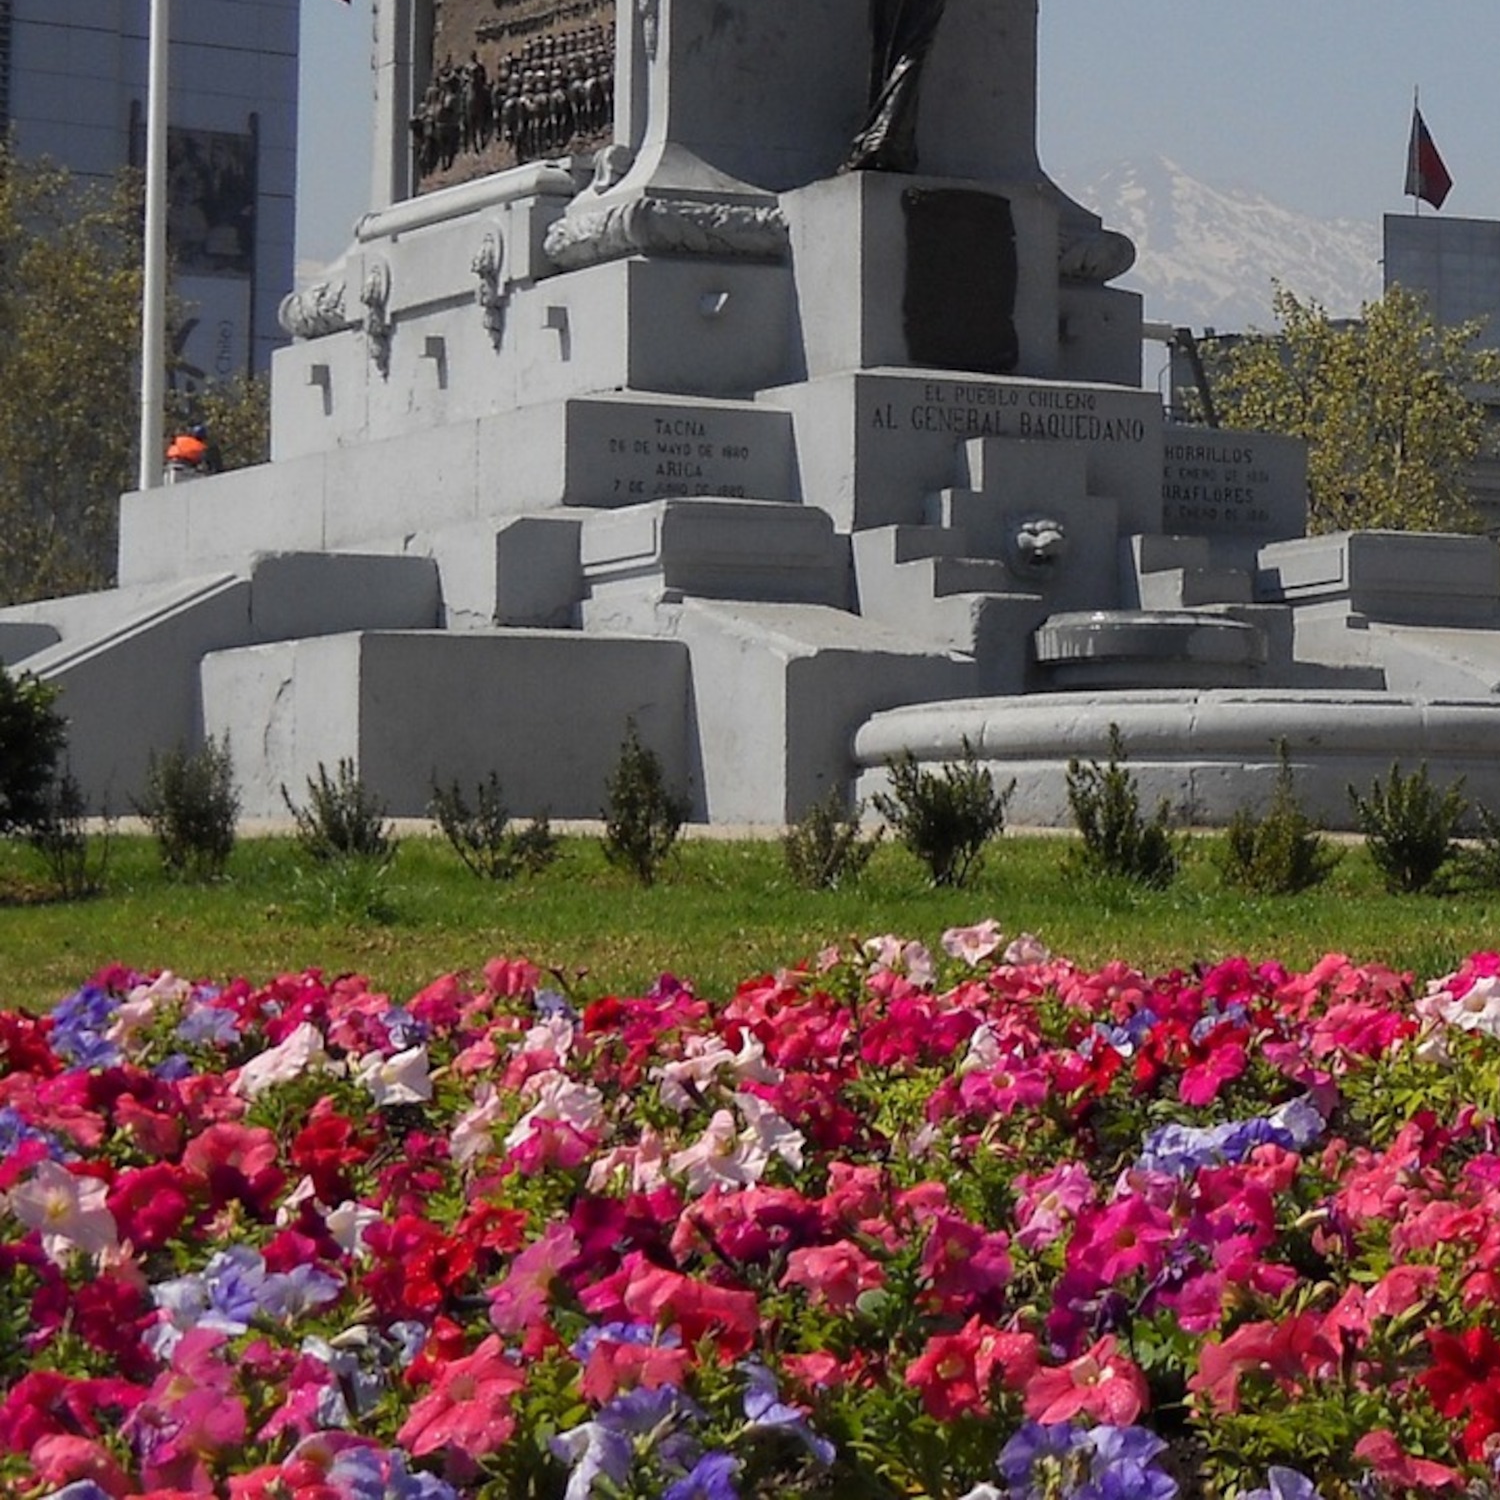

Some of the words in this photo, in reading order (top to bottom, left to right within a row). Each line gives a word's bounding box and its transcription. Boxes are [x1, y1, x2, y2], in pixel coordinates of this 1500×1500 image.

[925, 384, 945, 402] EL
[955, 386, 1019, 406] PUEBLO
[1028, 390, 1096, 412] CHILENO
[654, 418, 706, 436] TACNA
[872, 403, 898, 430] AL
[911, 405, 1008, 437] GENERAL
[1020, 412, 1145, 442] BAQUEDANO
[633, 440, 650, 455] DE
[657, 442, 691, 457] MAYO
[697, 444, 714, 458] DE
[1164, 445, 1254, 464] HORRILLOS
[656, 461, 703, 477] ARICA
[613, 479, 622, 492] 7
[628, 480, 645, 493] DE
[1162, 485, 1255, 504] IRAFLORES
